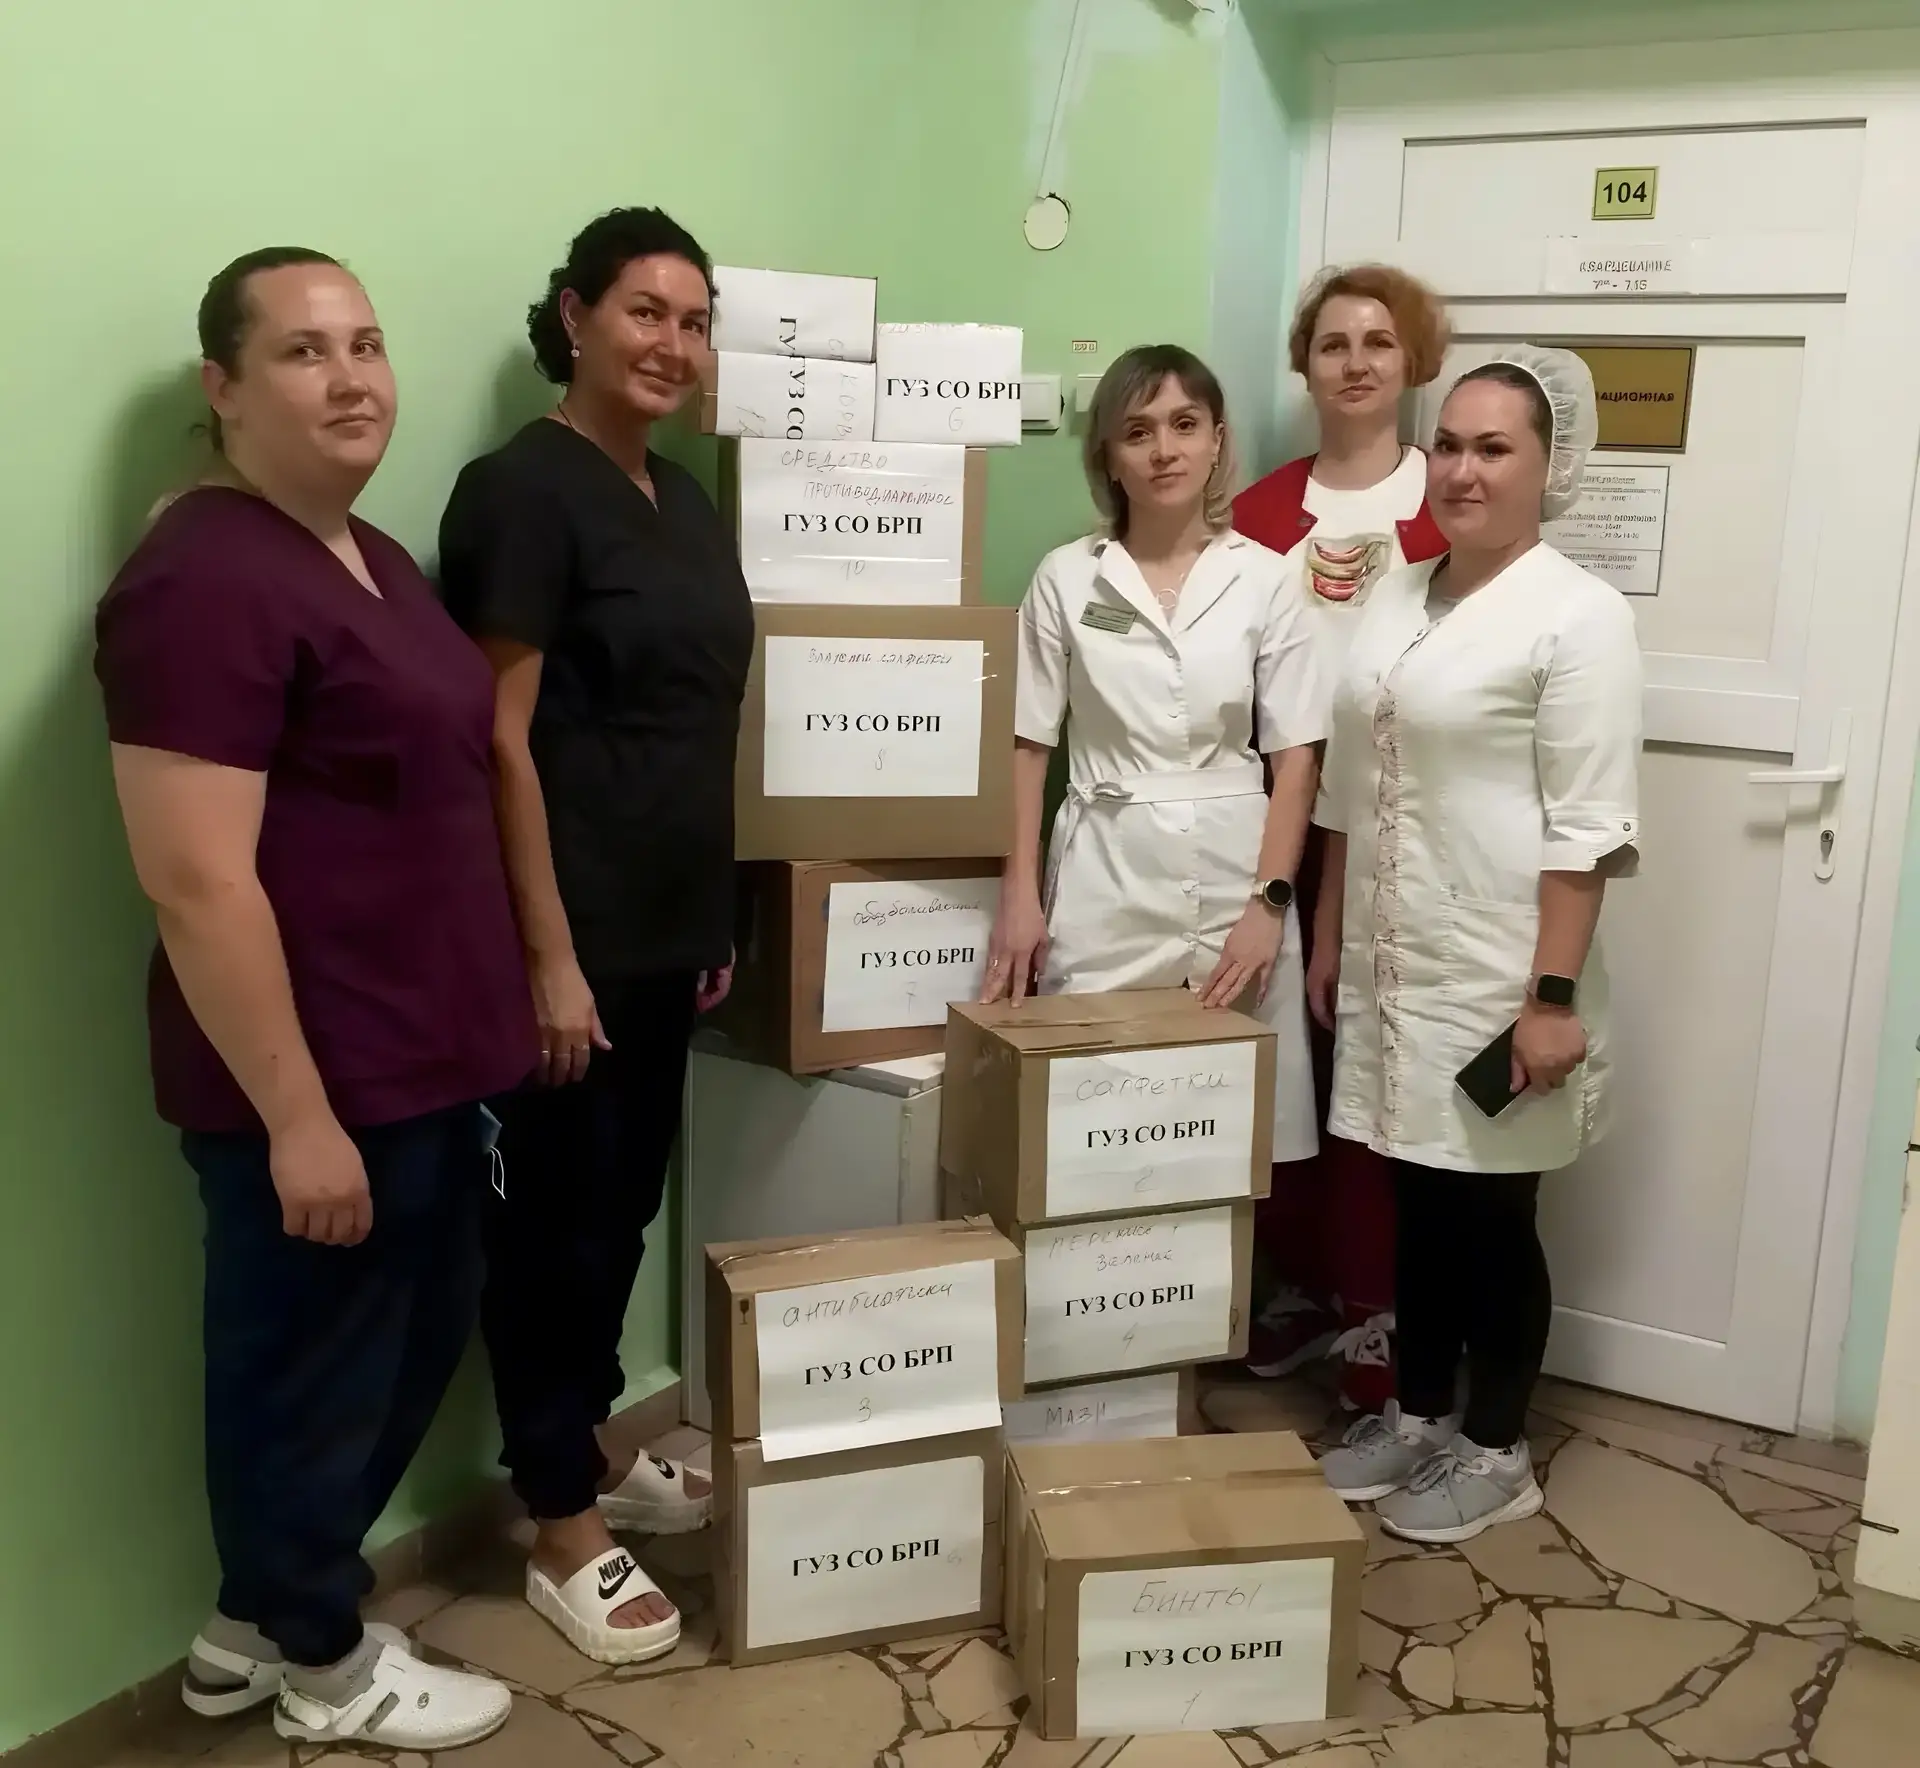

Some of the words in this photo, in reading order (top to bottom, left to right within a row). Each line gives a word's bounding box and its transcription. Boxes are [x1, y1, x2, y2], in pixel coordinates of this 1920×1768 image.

[1603, 181, 1647, 204] 104
[779, 316, 799, 357] ГУ
[886, 378, 929, 399] ГУЗ
[936, 379, 970, 400] СО
[978, 381, 1022, 401] БРП
[1595, 391, 1675, 402] АЦИОННАЯ
[781, 449, 888, 472] СРЕДСТВО
[783, 513, 827, 532] ГУЗ
[834, 515, 869, 534] СО
[877, 516, 922, 535] БРП
[805, 714, 848, 732] ГУЗ
[855, 714, 889, 732] СО
[897, 715, 941, 733] БРП
[860, 951, 897, 969] ГУЗ
[902, 949, 931, 967] СО
[936, 947, 975, 965] БРП
[1087, 1128, 1128, 1148] ГУЗ
[1134, 1124, 1166, 1144] СО
[1173, 1119, 1215, 1140] БРП
[1065, 1295, 1106, 1317] ГУЗ
[1113, 1291, 1145, 1310] СО
[1152, 1284, 1195, 1305] БРП
[804, 1361, 852, 1385] ГУЗ
[859, 1353, 896, 1376] СО
[904, 1345, 954, 1369] БРП
[857, 1397, 872, 1423] 3
[597, 1555, 631, 1583] NIKE
[792, 1553, 839, 1577] ГУЗ
[846, 1547, 883, 1568] СО
[892, 1538, 940, 1562] БРП
[1125, 1648, 1174, 1668] ГУЗ
[1182, 1645, 1222, 1664] СО
[1231, 1640, 1283, 1661] БРП
